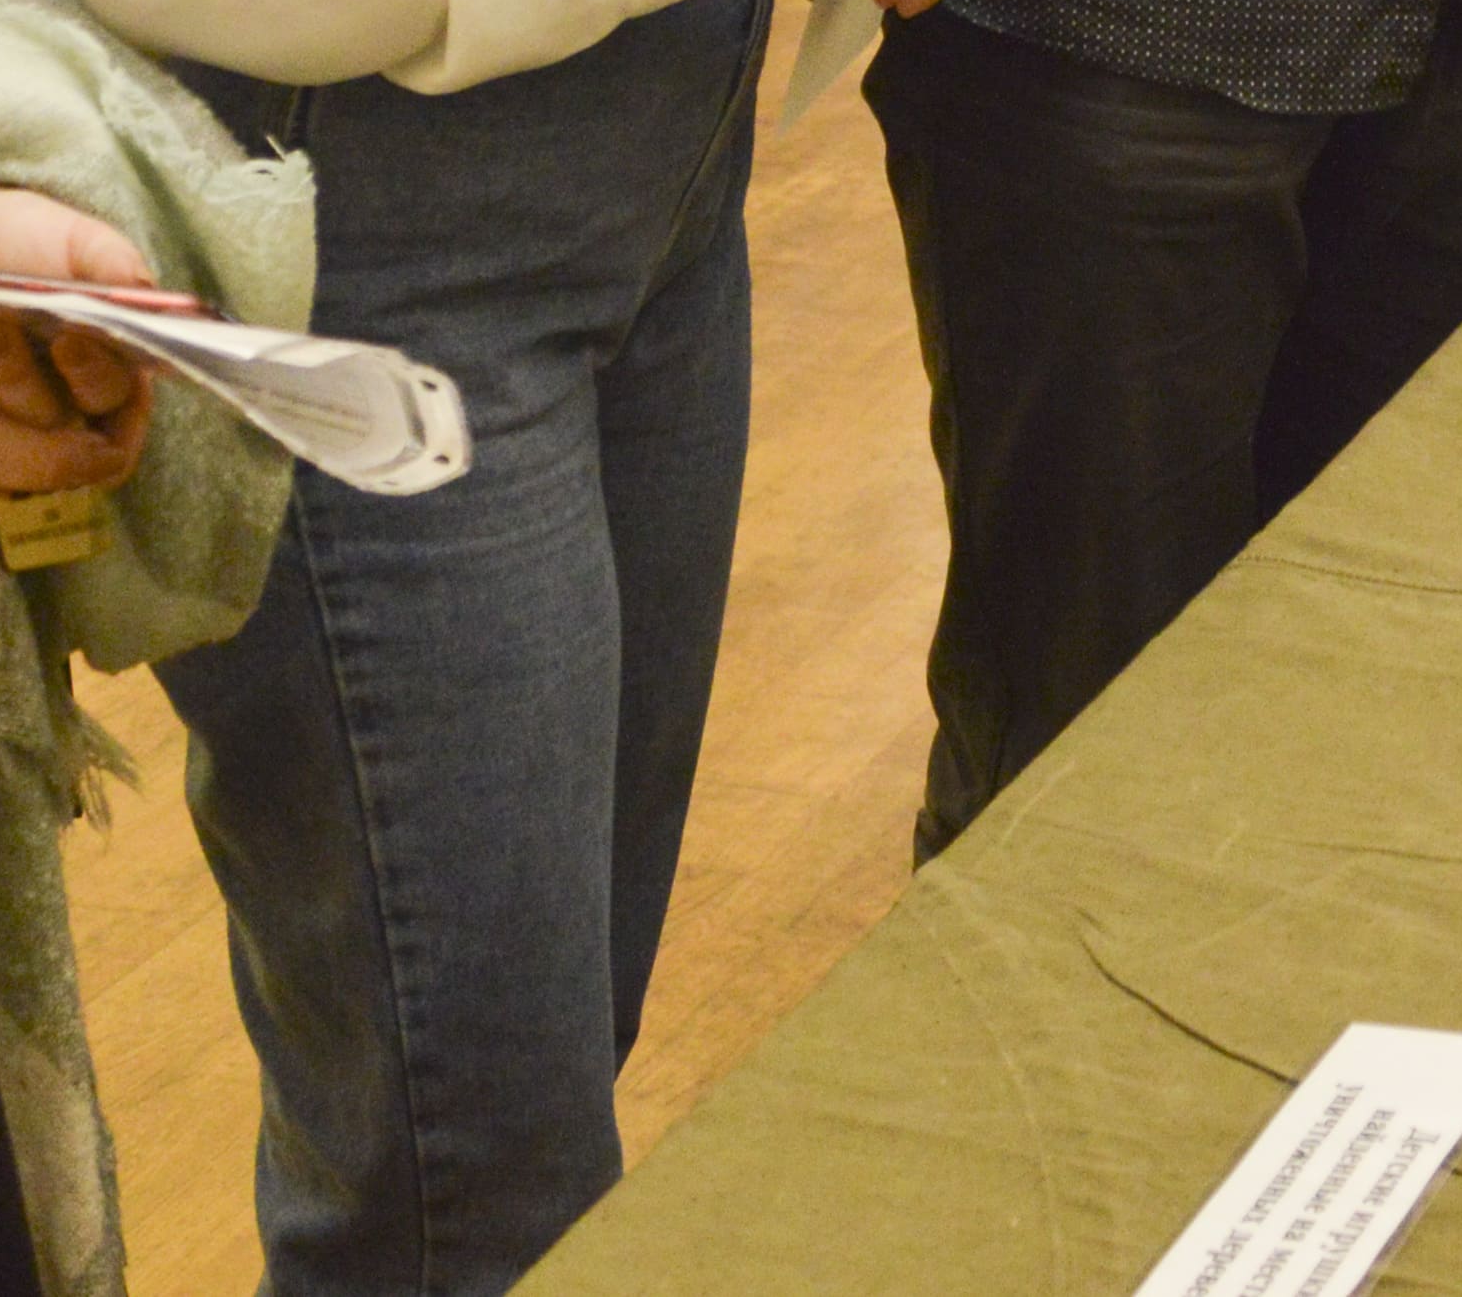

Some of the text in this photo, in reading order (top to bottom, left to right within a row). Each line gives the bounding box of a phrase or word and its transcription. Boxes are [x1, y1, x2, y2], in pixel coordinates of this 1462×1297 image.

[1241, 1082, 1365, 1225] уничтоженных
[1305, 1108, 1396, 1213] найденные
[1363, 1127, 1441, 1209] Детские
[1283, 1217, 1317, 1243] на
